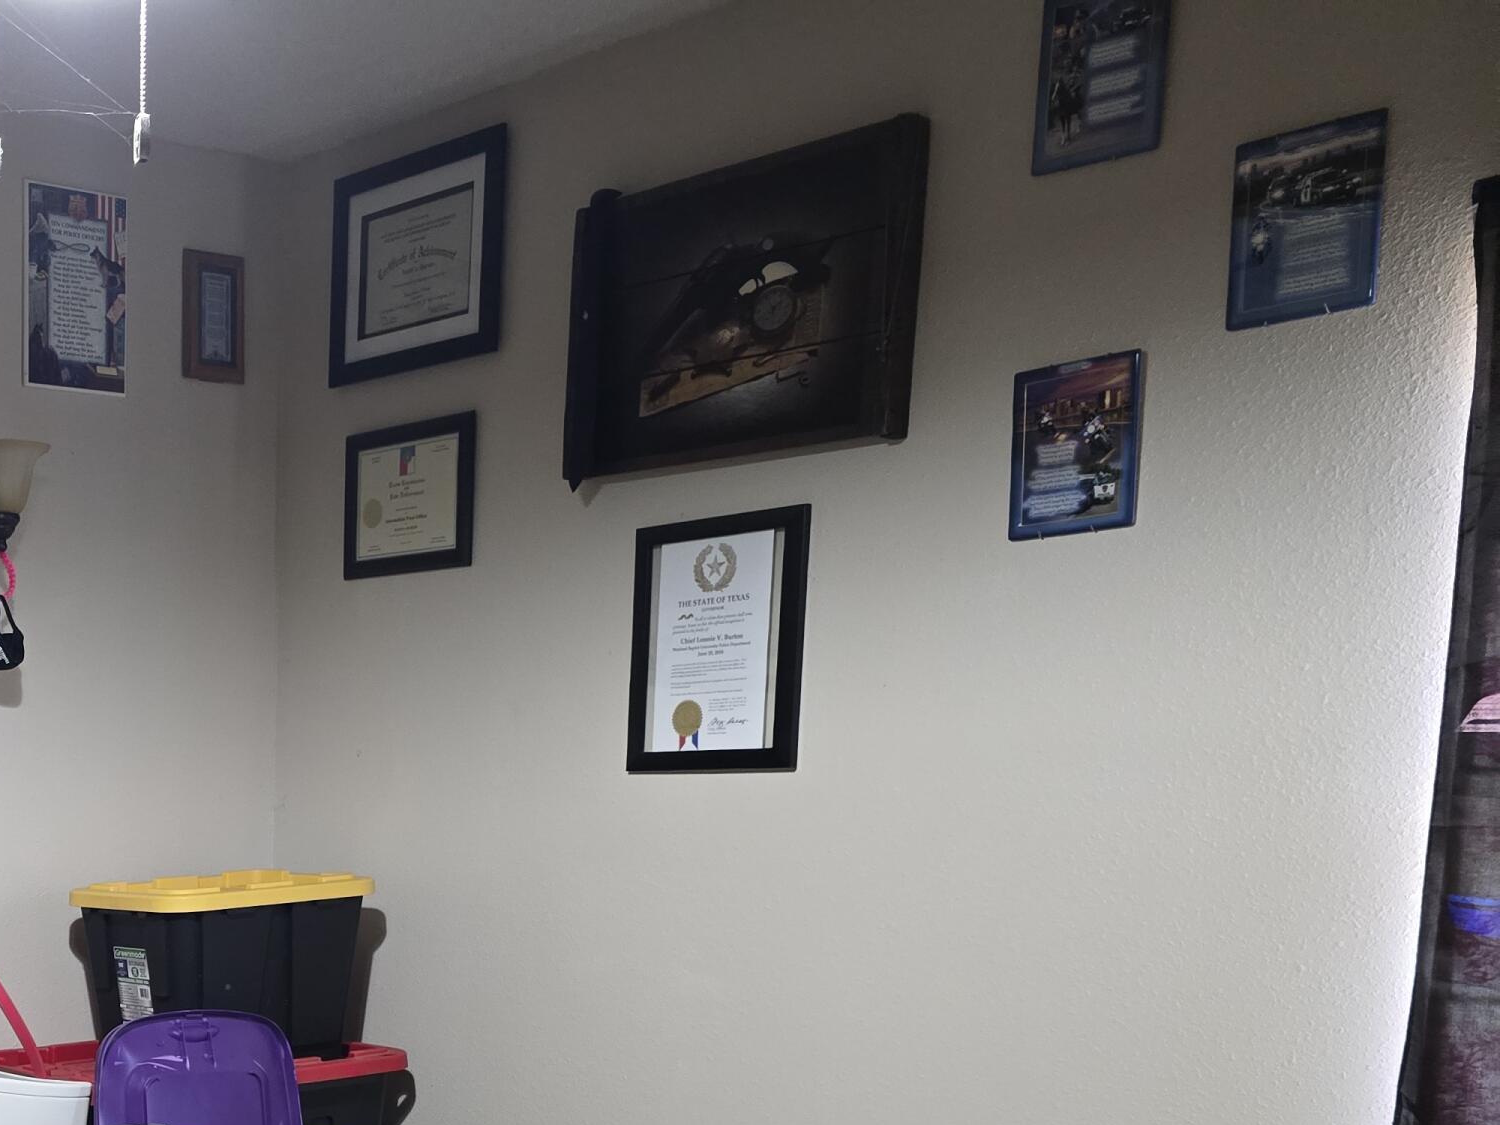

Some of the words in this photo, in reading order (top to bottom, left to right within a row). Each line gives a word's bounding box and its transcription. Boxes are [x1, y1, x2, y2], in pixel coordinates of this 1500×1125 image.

[678, 600, 693, 608] THE
[692, 597, 715, 607] STATE
[715, 595, 726, 604] OF
[727, 592, 750, 602] TEXAS
